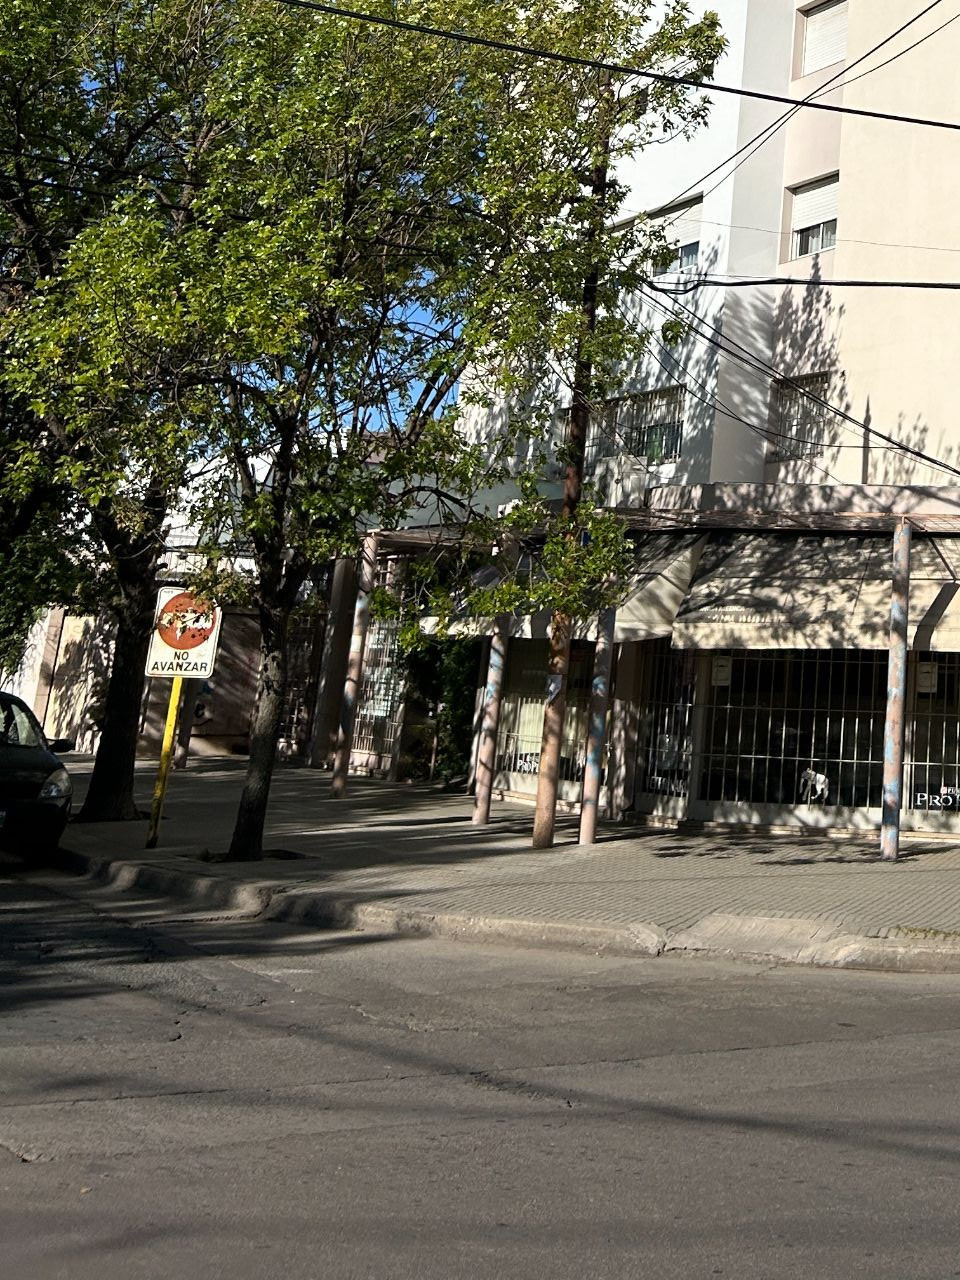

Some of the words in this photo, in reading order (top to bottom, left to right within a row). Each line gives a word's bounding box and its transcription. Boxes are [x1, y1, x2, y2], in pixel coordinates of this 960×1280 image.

[174, 652, 189, 661] NO
[152, 661, 208, 672] AVANZAR
[915, 792, 953, 807] PRO
